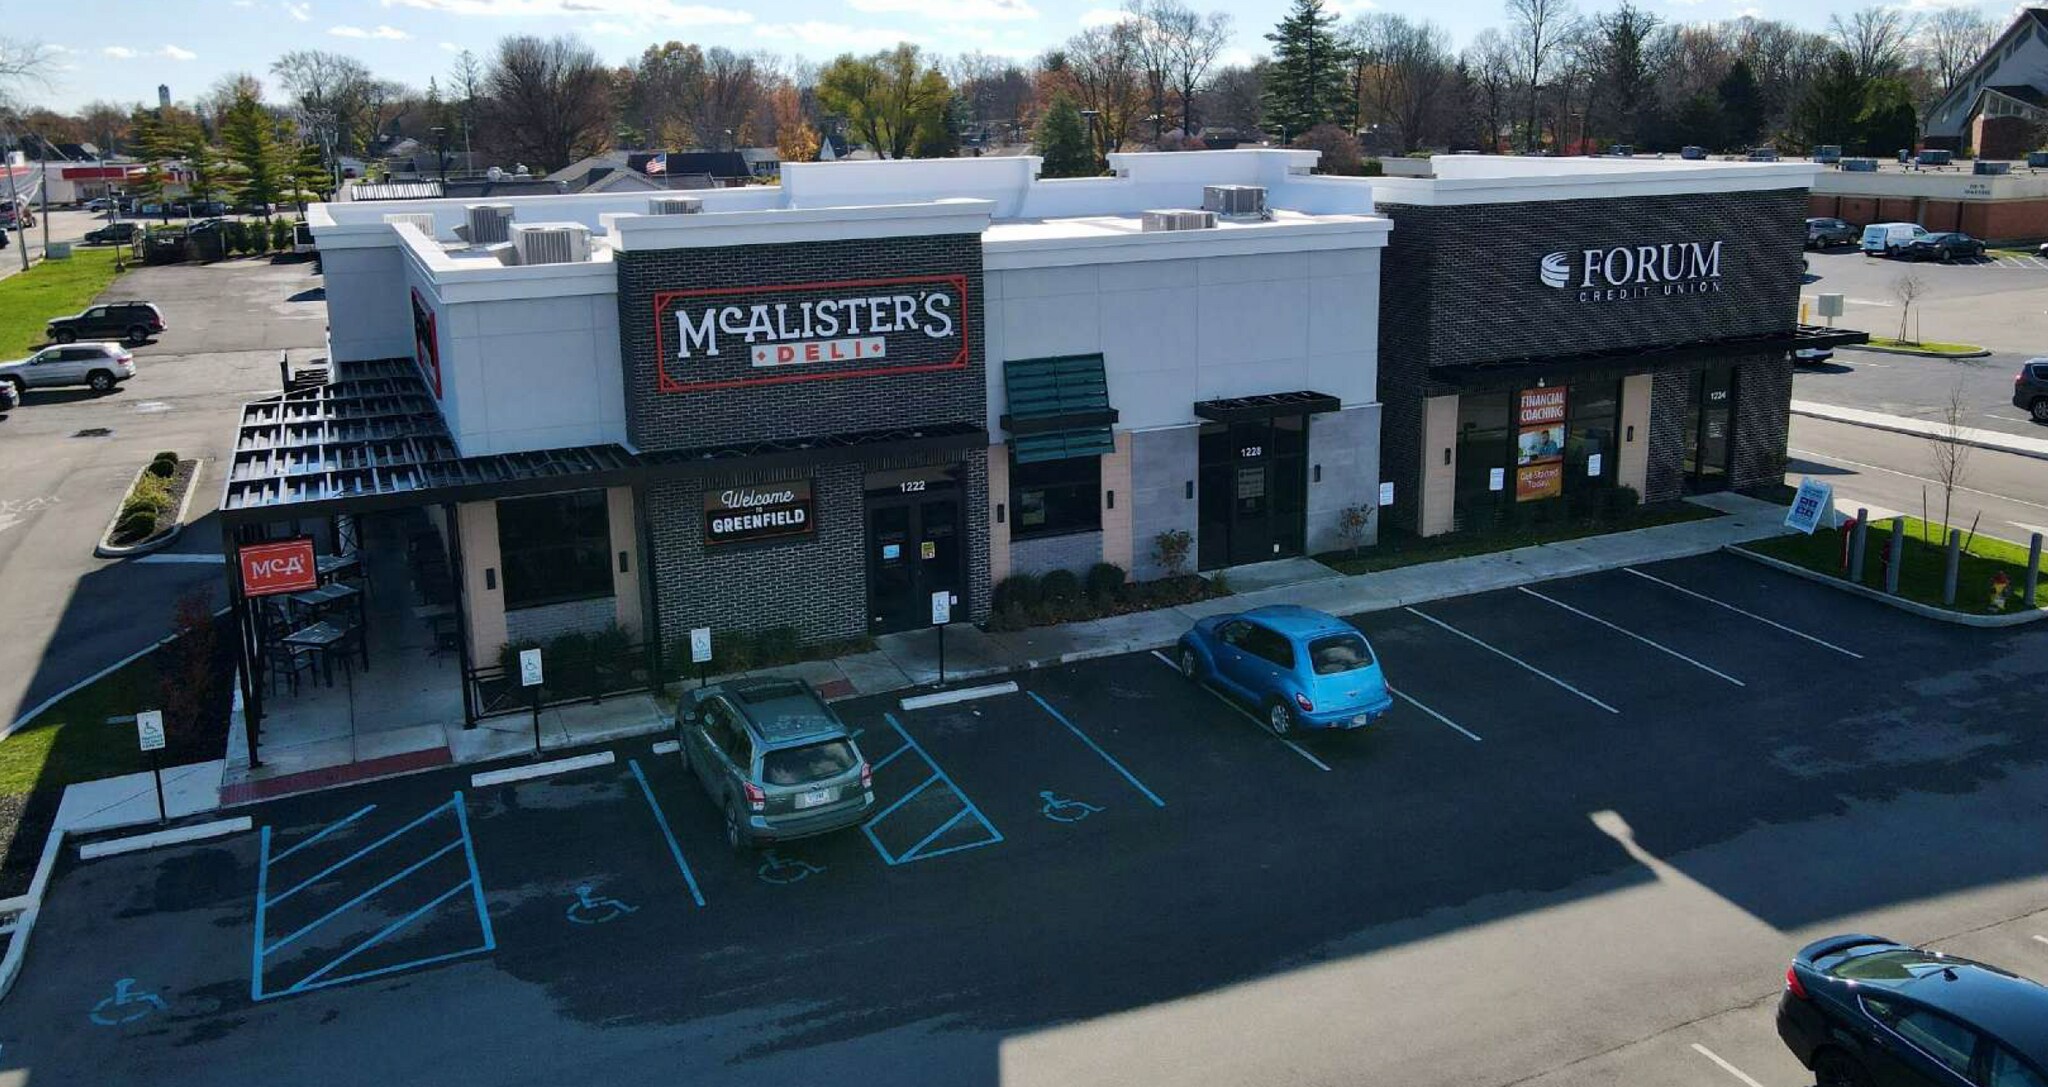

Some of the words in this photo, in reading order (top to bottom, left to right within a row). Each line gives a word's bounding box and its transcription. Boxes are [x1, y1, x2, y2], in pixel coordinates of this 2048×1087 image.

[1581, 240, 1723, 289] FORUM
[1579, 286, 1650, 302] CREDIT
[1664, 281, 1720, 296] UNION
[776, 340, 862, 363] DELI
[1521, 391, 1565, 408] FINANCIAL
[1521, 405, 1564, 421] COACHING
[900, 480, 926, 493] 1222
[721, 489, 795, 509] Welcome
[712, 508, 806, 534] GREENFIELD
